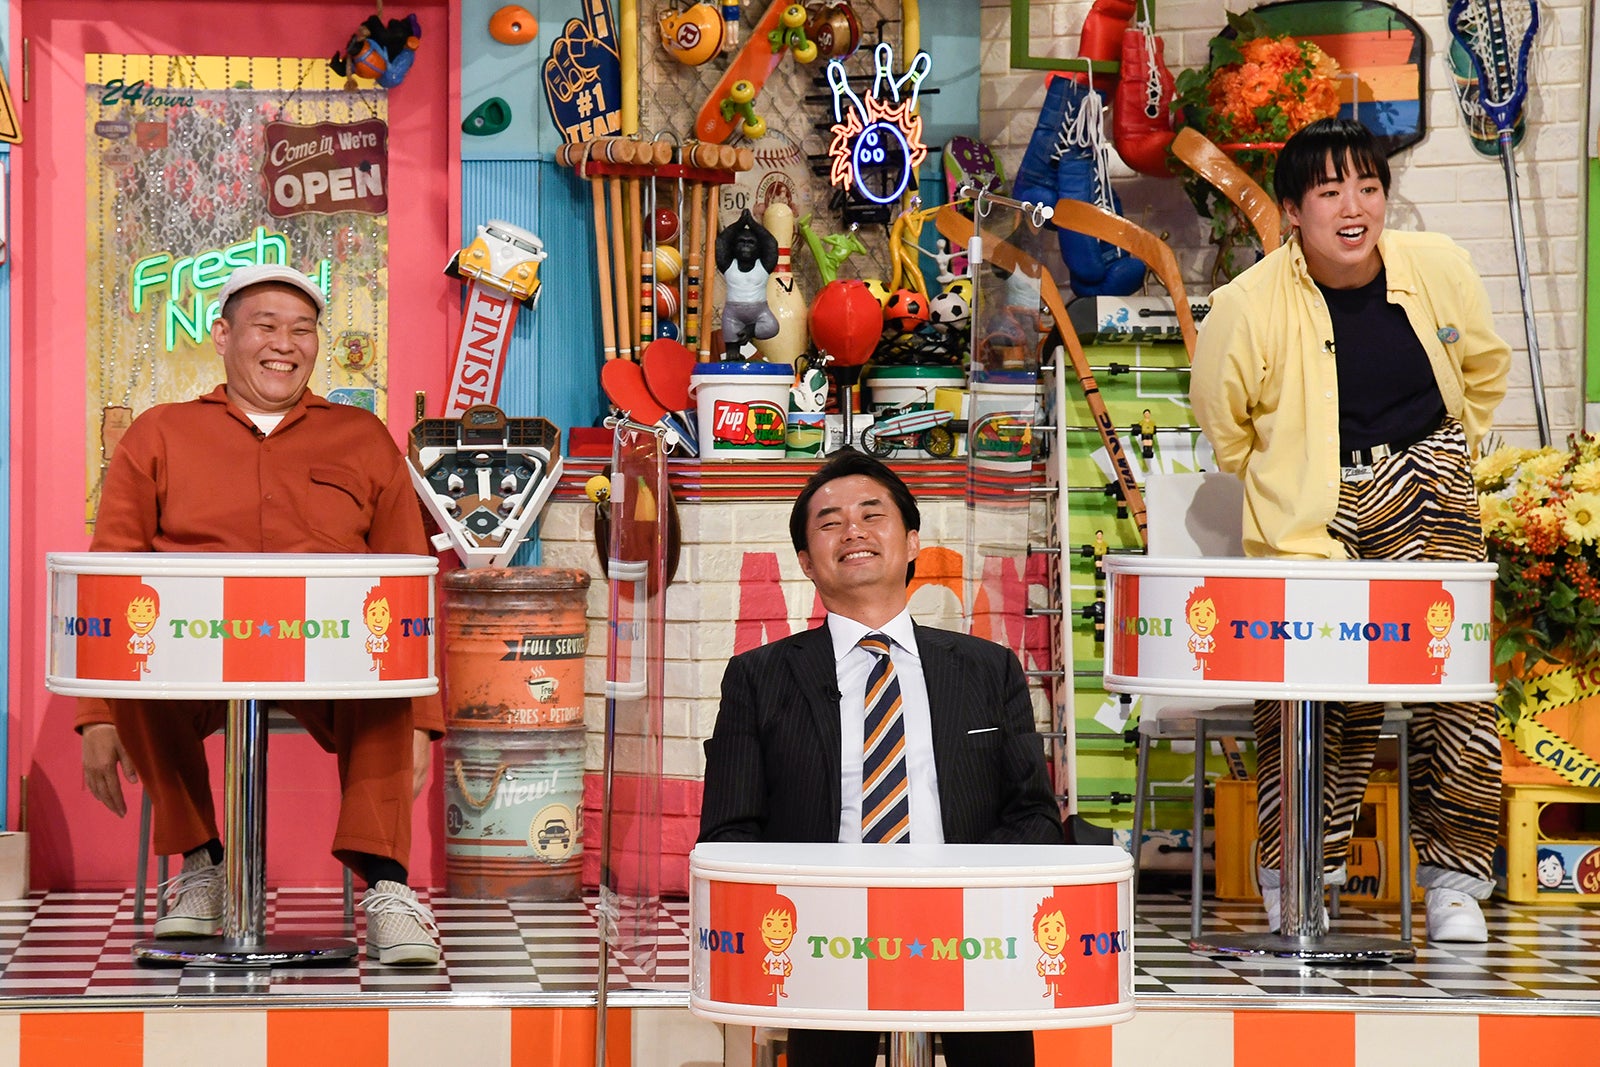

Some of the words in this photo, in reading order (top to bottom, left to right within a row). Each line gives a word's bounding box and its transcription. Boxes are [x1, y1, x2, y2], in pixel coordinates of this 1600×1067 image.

[577, 82, 606, 118] #1
[271, 139, 317, 167] Come
[320, 135, 334, 155] in
[338, 131, 377, 151] We're
[274, 164, 384, 208] OPEN
[133, 226, 287, 313] Fresh
[453, 290, 507, 413] FINISH
[716, 405, 745, 431] 7up
[64, 616, 112, 637] MORI
[169, 619, 254, 640] TOKU
[278, 619, 351, 640] MORI
[1125, 616, 1172, 637] MORI
[1230, 619, 1315, 641] TOKU
[1339, 621, 1411, 643] MORI
[523, 639, 552, 656] FULL
[494, 769, 560, 810] New!
[698, 927, 745, 954] MORI
[808, 936, 900, 960] TOKU
[931, 936, 1017, 960] MORI
